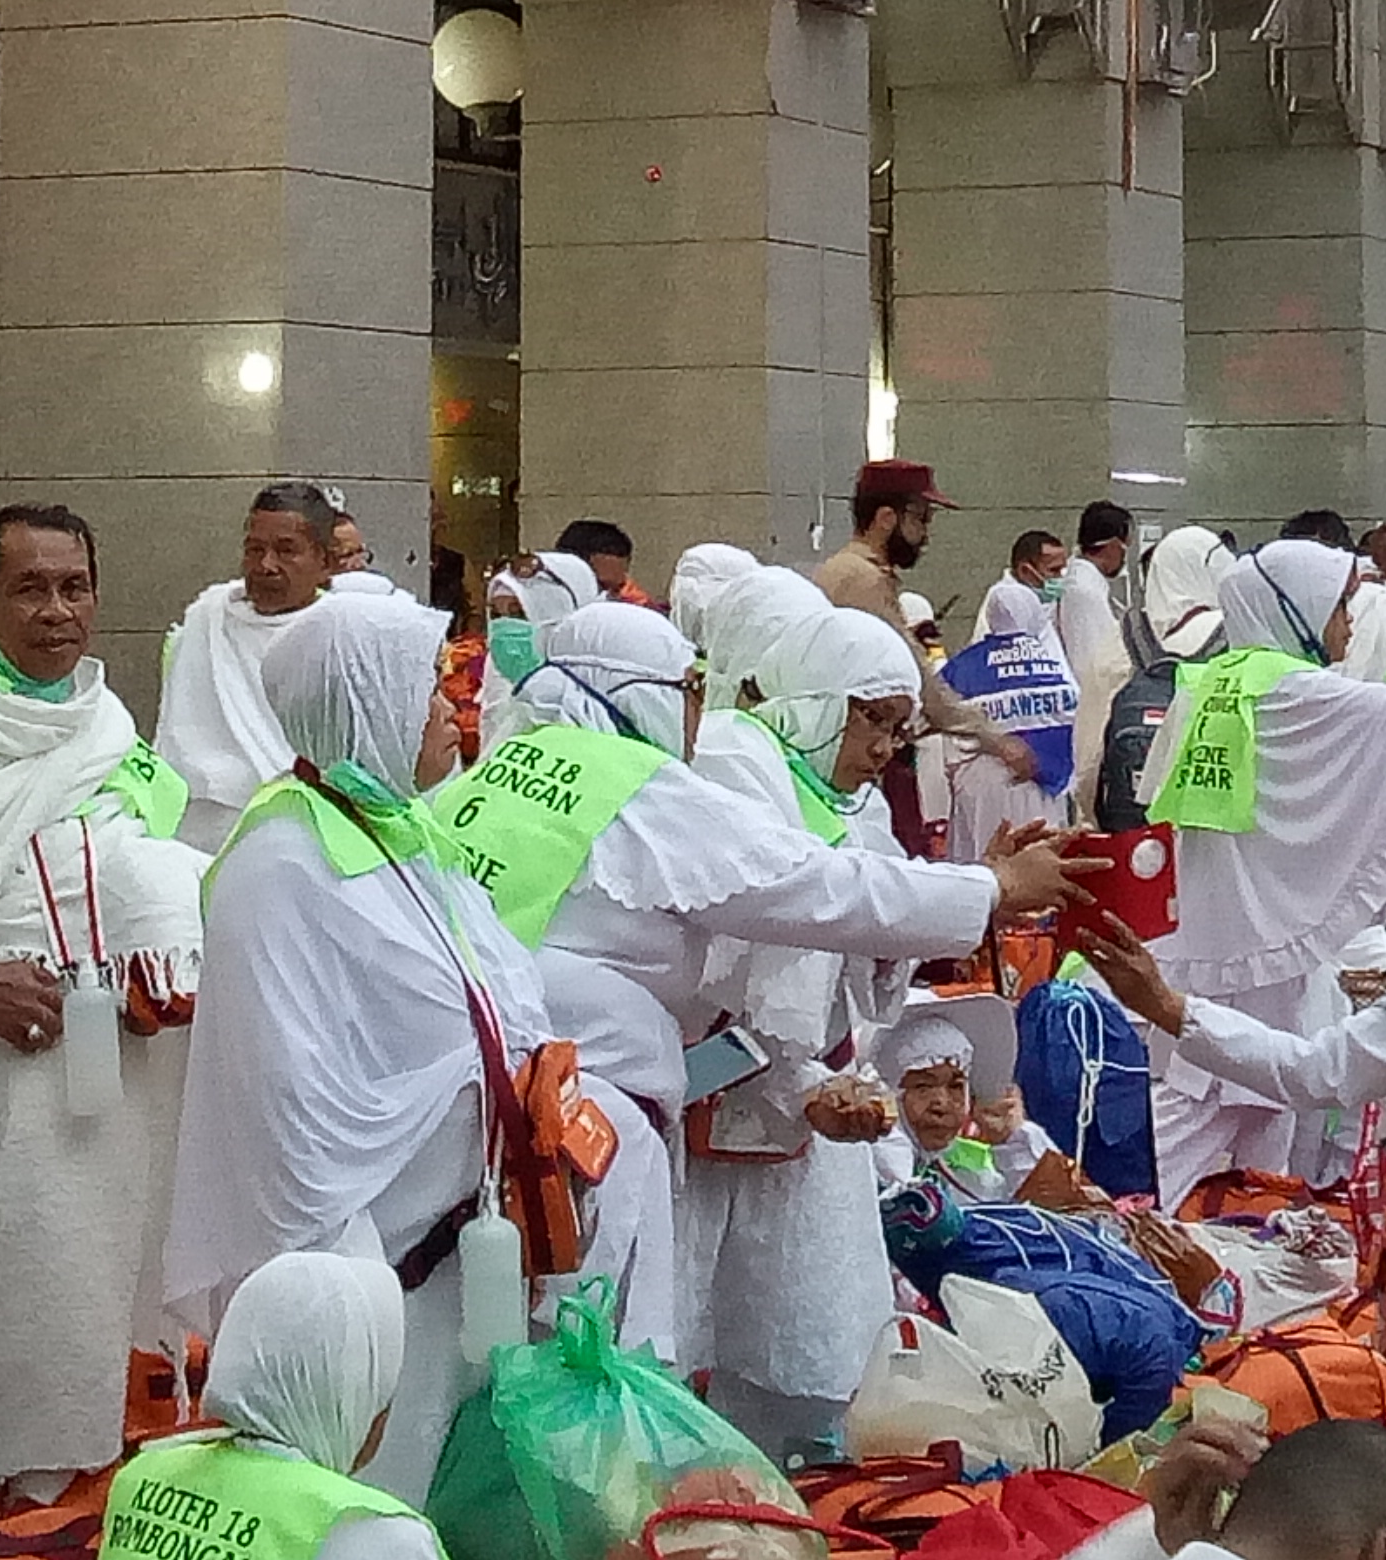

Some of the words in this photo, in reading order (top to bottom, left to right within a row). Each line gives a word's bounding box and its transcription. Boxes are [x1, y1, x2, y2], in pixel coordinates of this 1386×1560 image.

[495, 741, 545, 771] TER
[543, 757, 583, 786] 18
[453, 796, 488, 829] 6
[130, 1477, 220, 1533] KLOTER
[218, 1510, 262, 1549] 18
